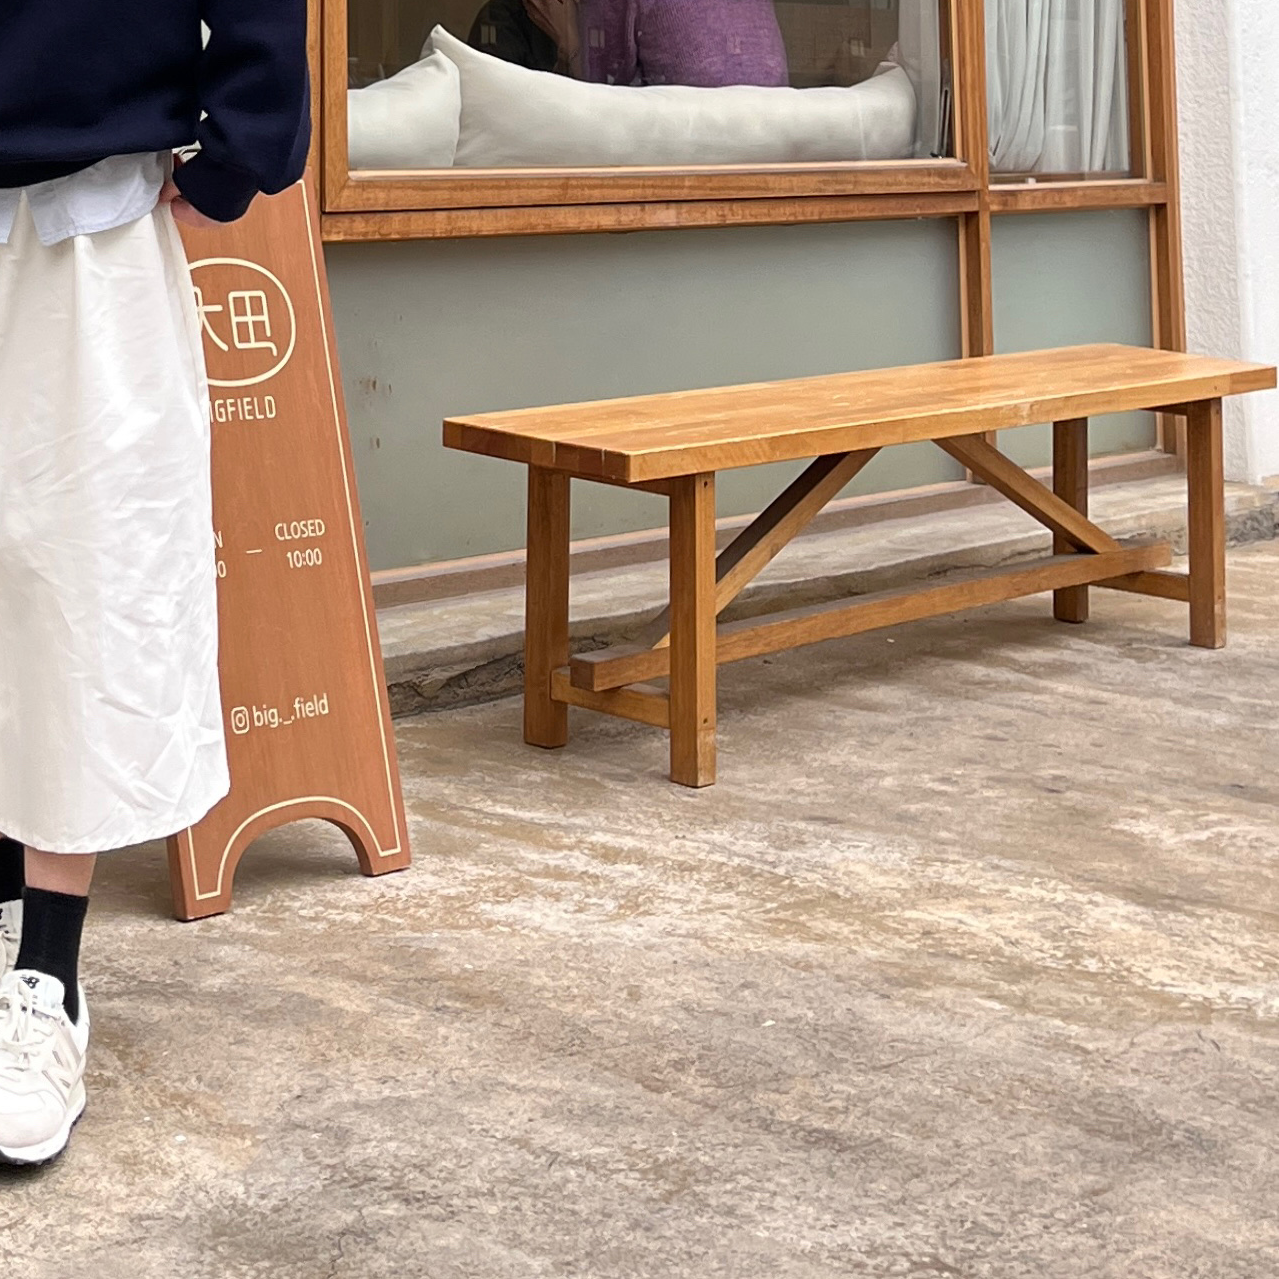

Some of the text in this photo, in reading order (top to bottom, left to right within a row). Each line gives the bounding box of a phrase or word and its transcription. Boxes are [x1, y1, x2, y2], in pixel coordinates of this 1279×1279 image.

[208, 395, 277, 423] IGFIELD
[274, 519, 326, 541] CLOSED
[286, 548, 323, 569] 10:00
